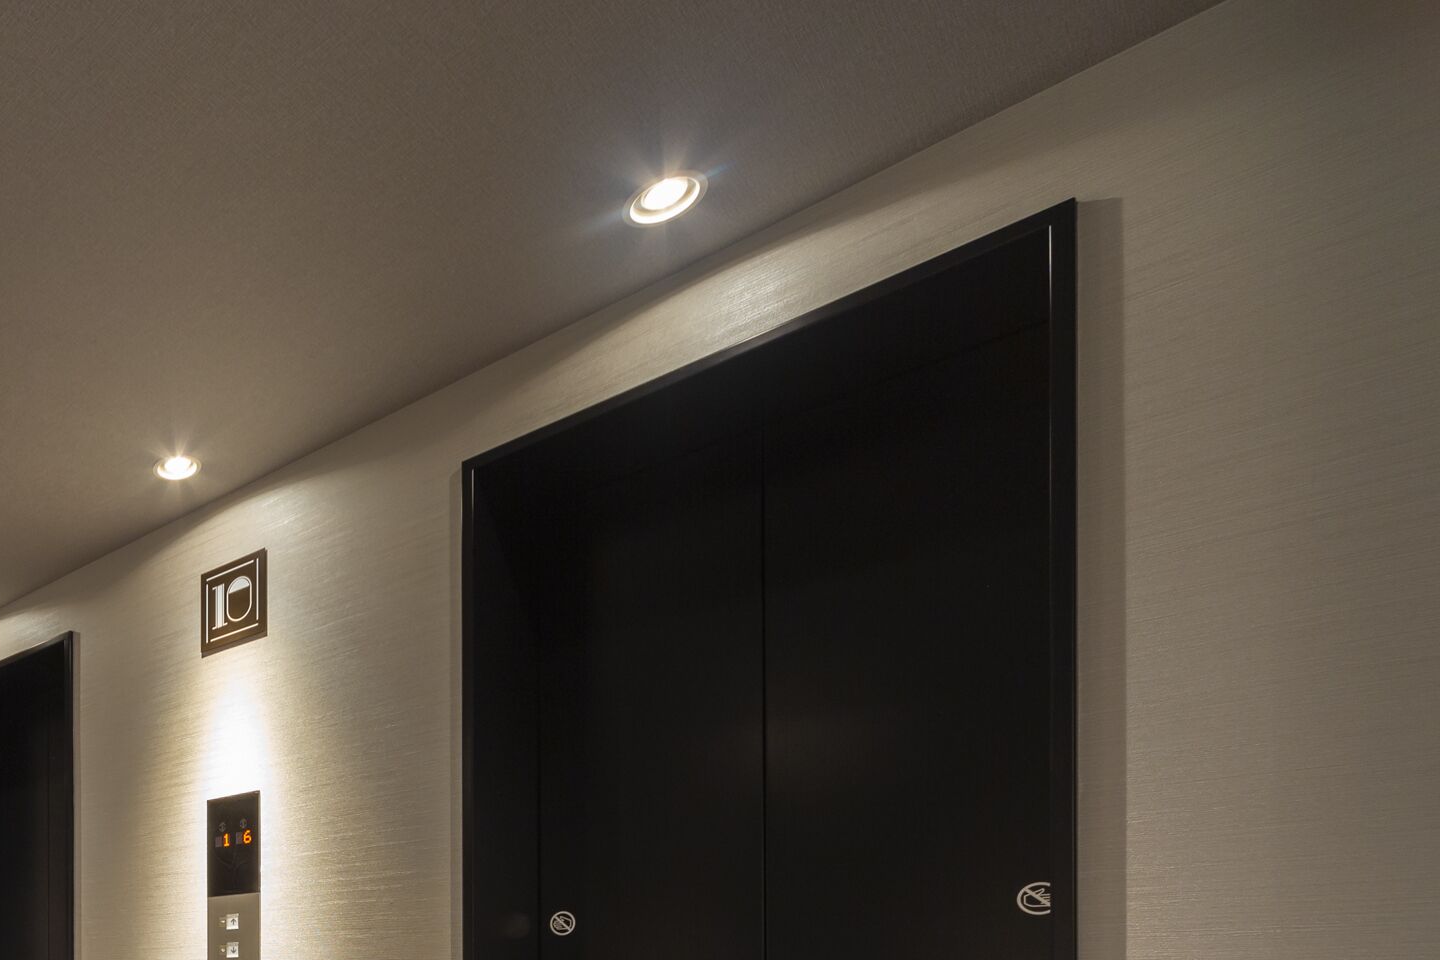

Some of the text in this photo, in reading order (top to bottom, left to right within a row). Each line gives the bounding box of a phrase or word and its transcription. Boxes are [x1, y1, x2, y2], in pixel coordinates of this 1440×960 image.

[212, 575, 252, 630] 10
[223, 829, 252, 847] 1 6
